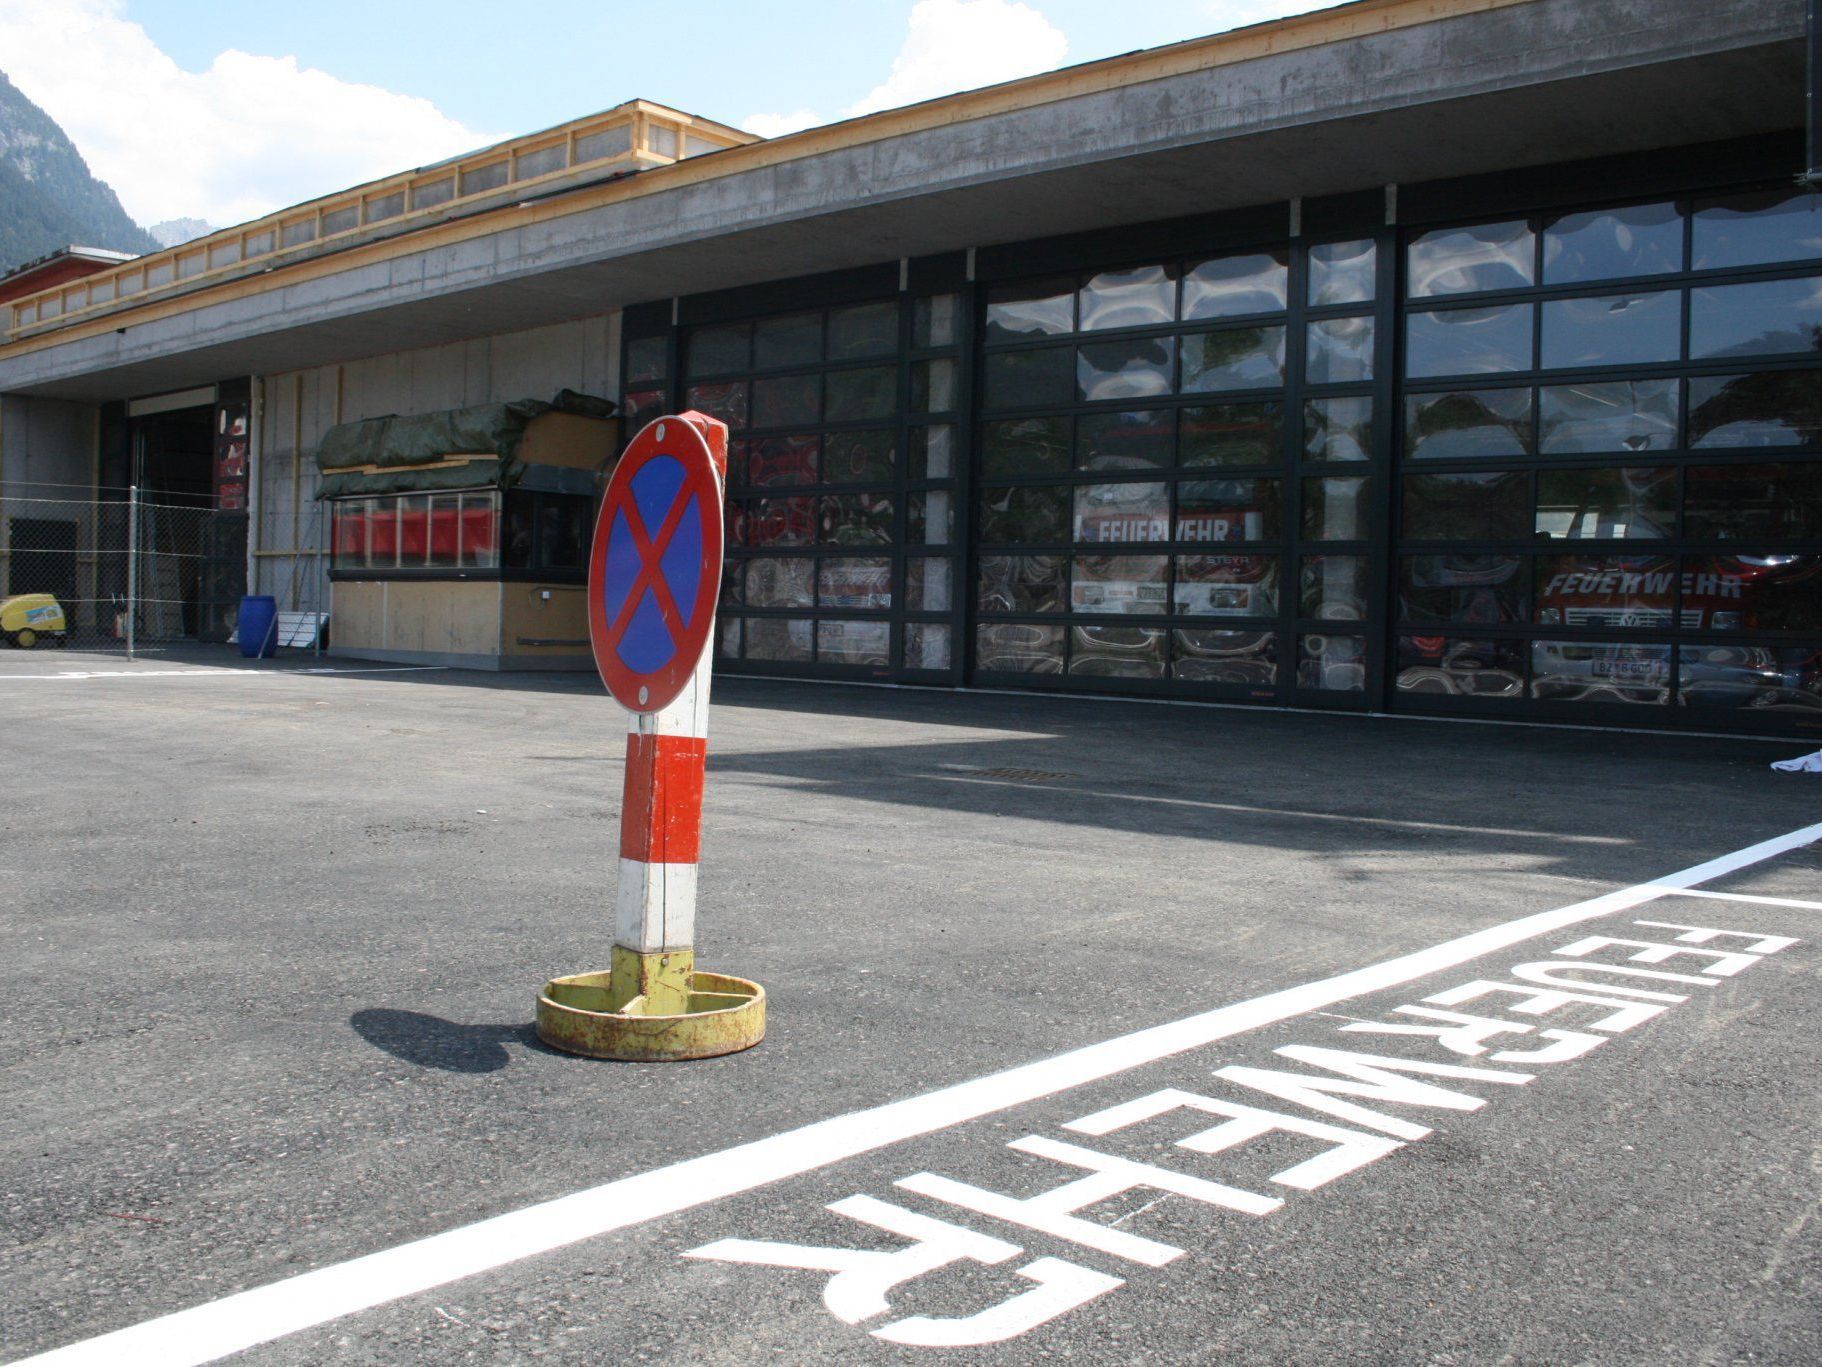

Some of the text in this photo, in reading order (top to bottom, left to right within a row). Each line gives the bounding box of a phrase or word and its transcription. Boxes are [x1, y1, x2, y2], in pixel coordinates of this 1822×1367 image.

[1099, 519, 1229, 542] FEUERWEHR
[1207, 556, 1249, 566] STEYR
[1543, 573, 1743, 598] FEUERWEHR
[682, 920, 1800, 1348] FEUERWEHR
